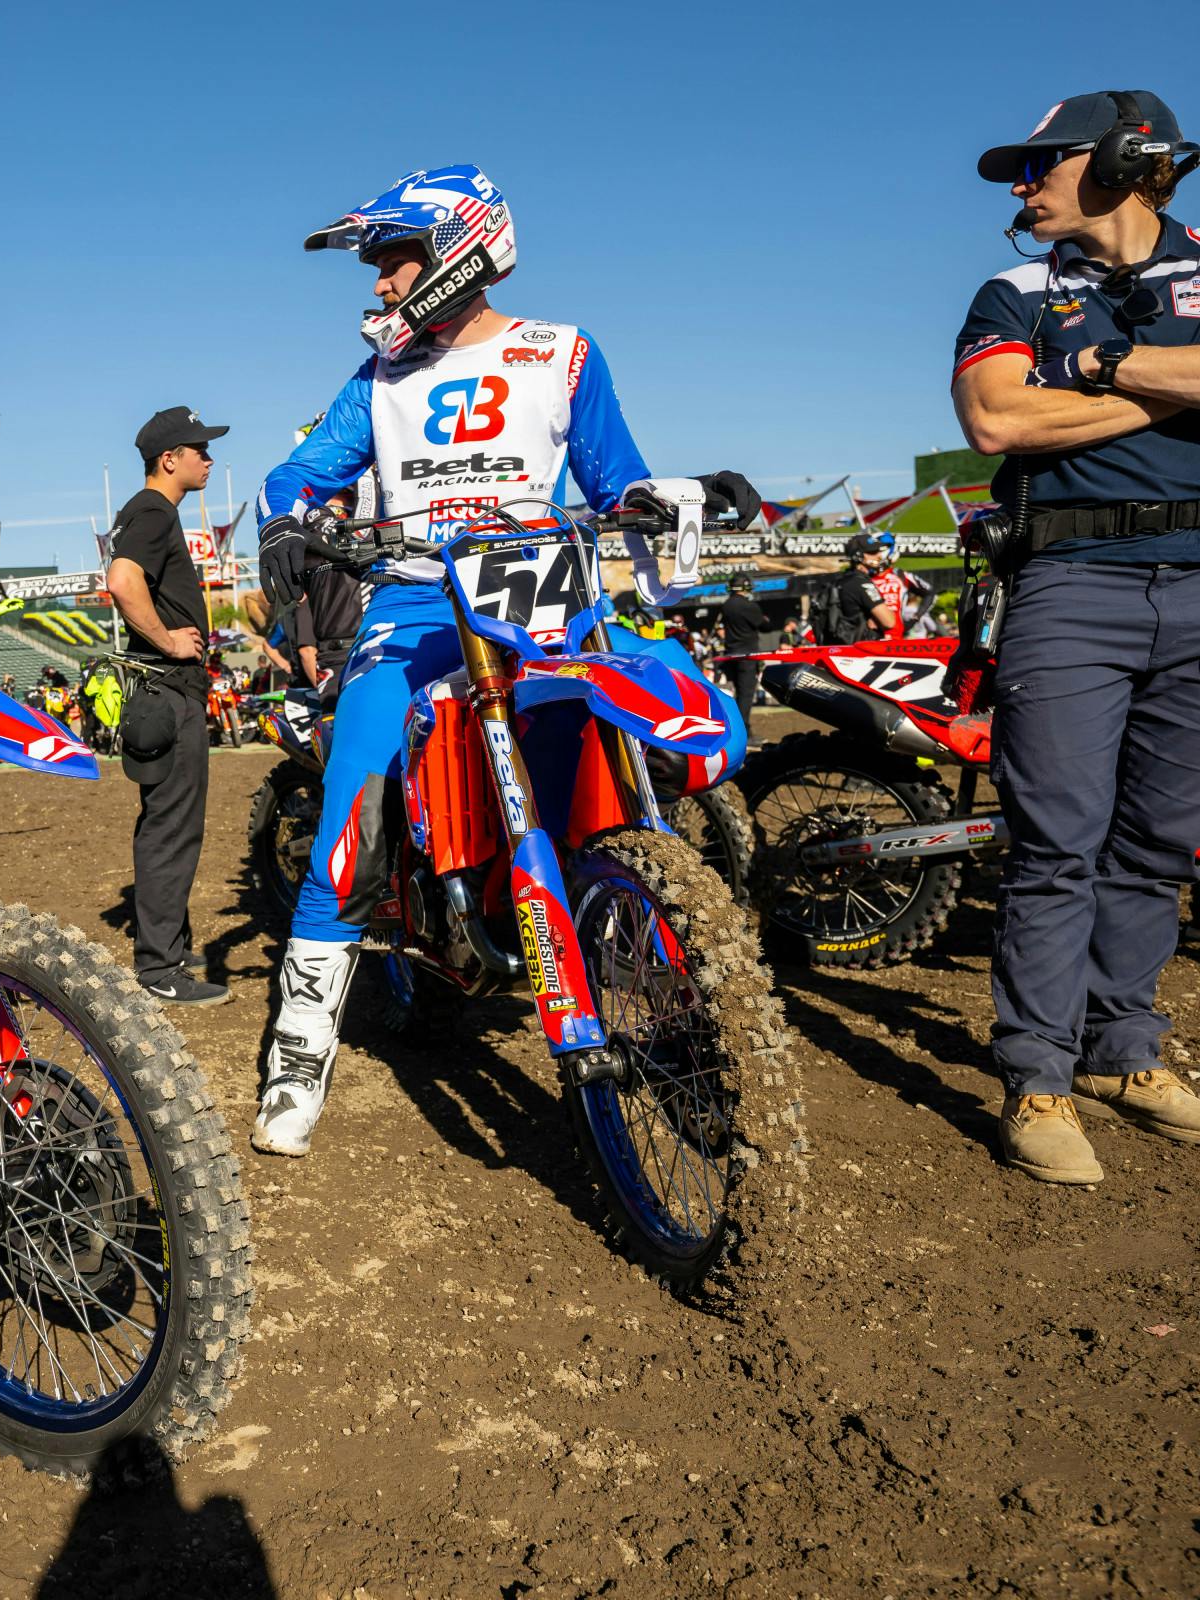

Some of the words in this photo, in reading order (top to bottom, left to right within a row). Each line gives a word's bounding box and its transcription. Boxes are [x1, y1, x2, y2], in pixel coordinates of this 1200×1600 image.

[409, 254, 484, 319] Insta360
[529, 330, 552, 340] Arai
[400, 452, 525, 481] Beta
[417, 475, 492, 490] RACING
[432, 498, 498, 521] LIQUI
[493, 536, 557, 549] SUPERCROSS
[19, 579, 45, 589] ROCKY
[46, 575, 90, 587] MOUNTAIN
[473, 545, 597, 629] 54
[885, 644, 954, 654] HOND
[859, 660, 940, 693] 17
[484, 720, 529, 835] Beta
[966, 823, 992, 836] RK
[517, 908, 544, 994] ACERBIS
[530, 900, 561, 993] BRIDGESTONE
[816, 935, 880, 952] DUNLOP
[159, 1217, 171, 1272] EXCEL
